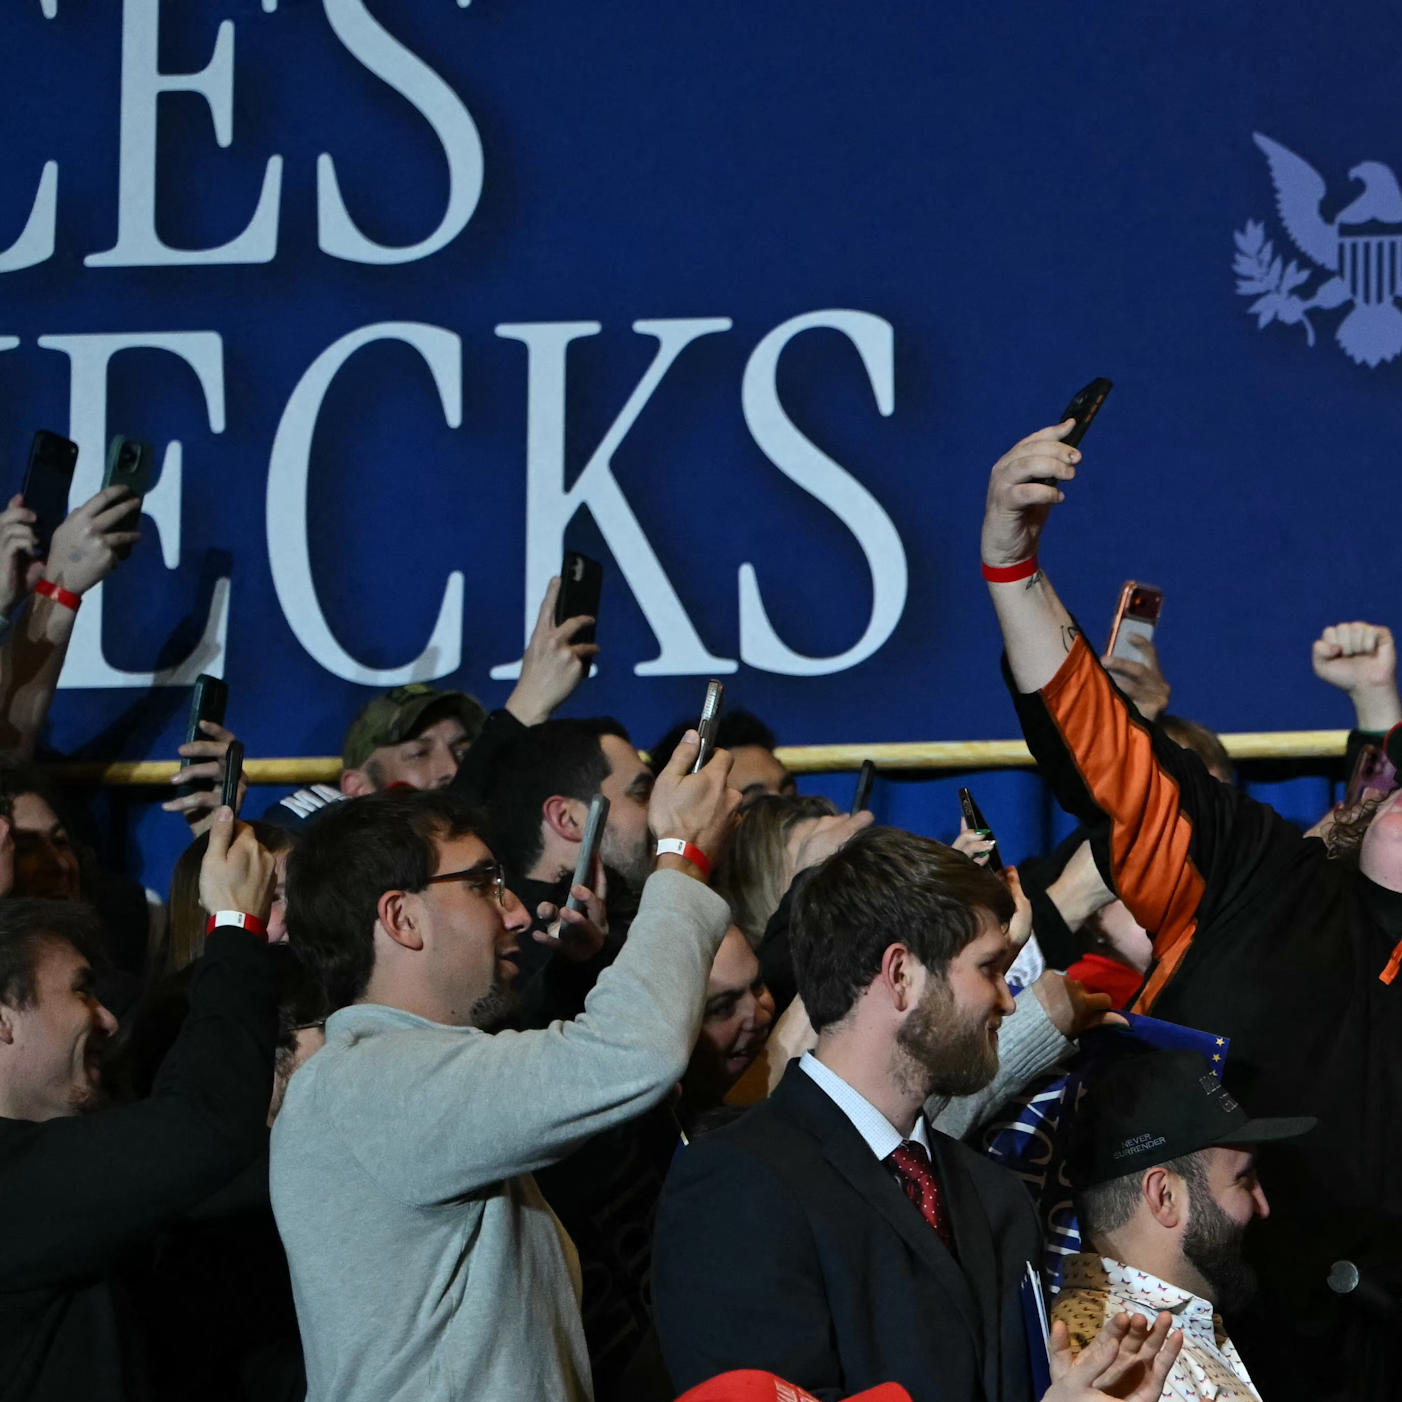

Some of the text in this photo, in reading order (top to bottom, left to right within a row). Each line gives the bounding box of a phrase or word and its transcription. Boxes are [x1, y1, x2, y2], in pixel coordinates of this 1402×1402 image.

[0, 0, 485, 273] ES
[0, 308, 908, 690] ECKS
[1112, 1136, 1166, 1160] SURRENDER
[1120, 1133, 1151, 1149] NEVER
